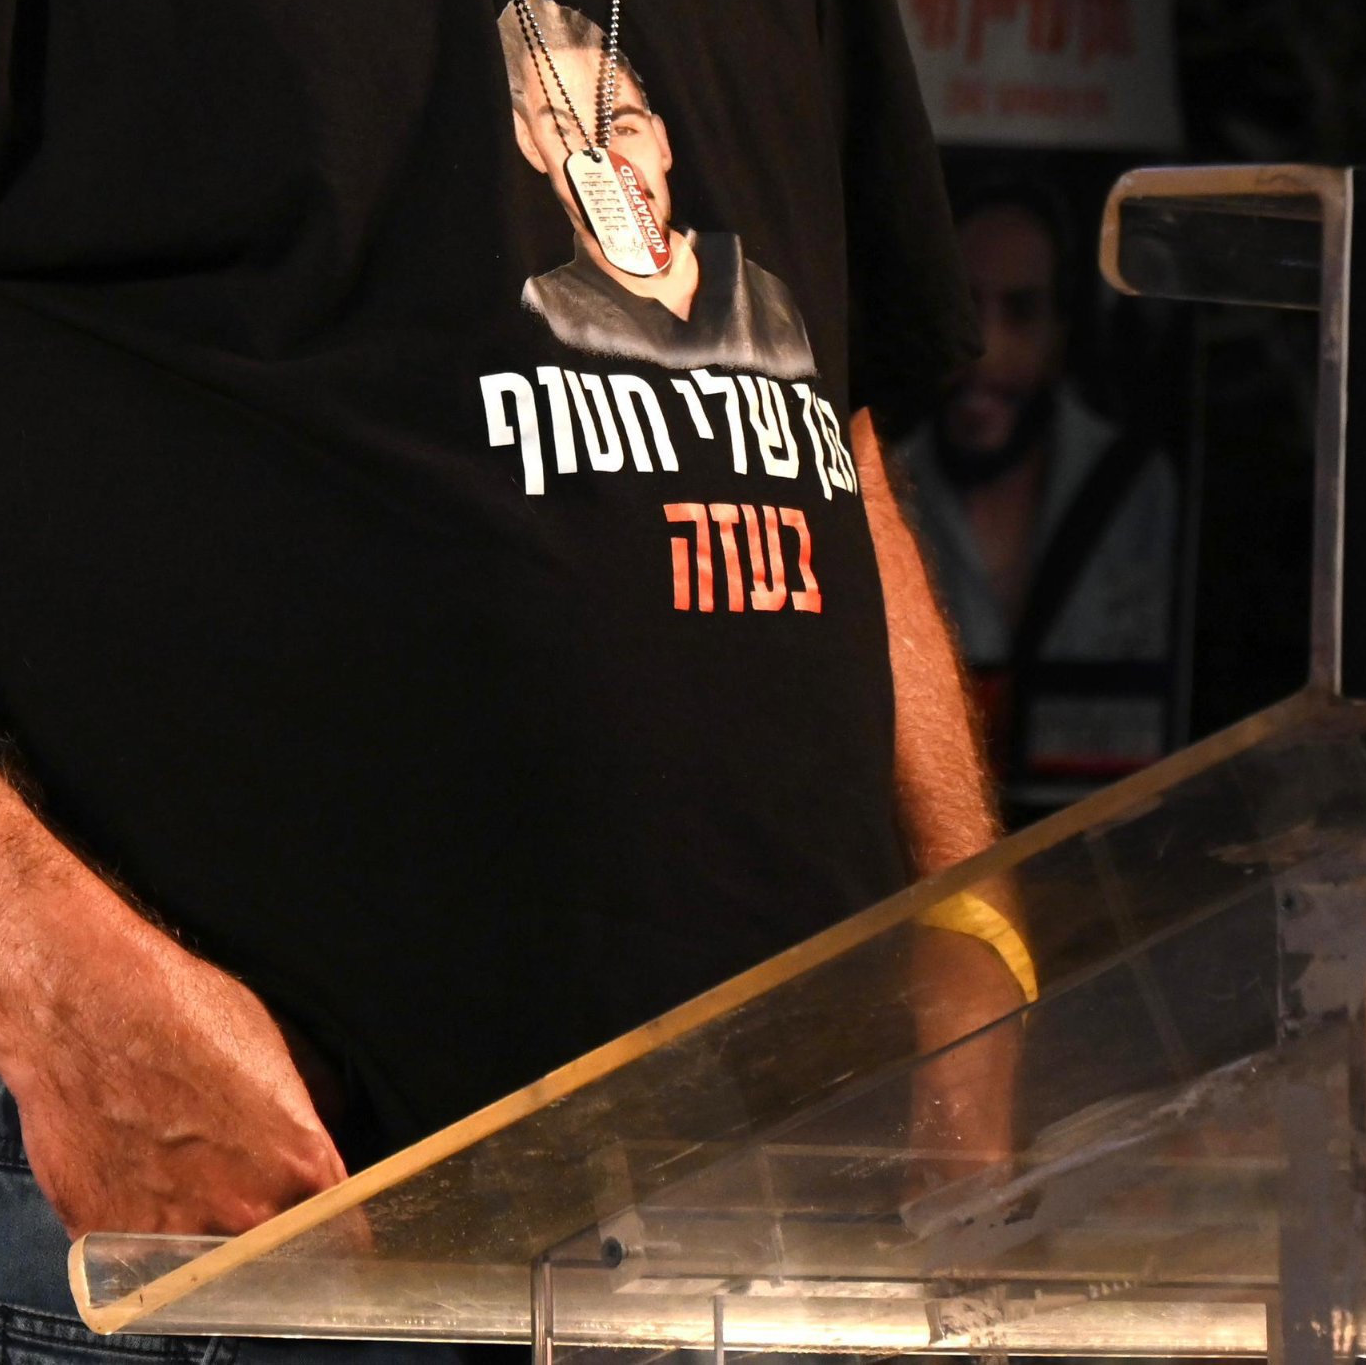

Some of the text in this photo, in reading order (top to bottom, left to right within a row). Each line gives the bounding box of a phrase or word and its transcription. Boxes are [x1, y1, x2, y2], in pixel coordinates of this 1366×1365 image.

[620, 164, 668, 254] KIDNAPPED
[479, 366, 680, 496] חטוף
[670, 369, 800, 479] שלי
[663, 502, 822, 614] בעזה
